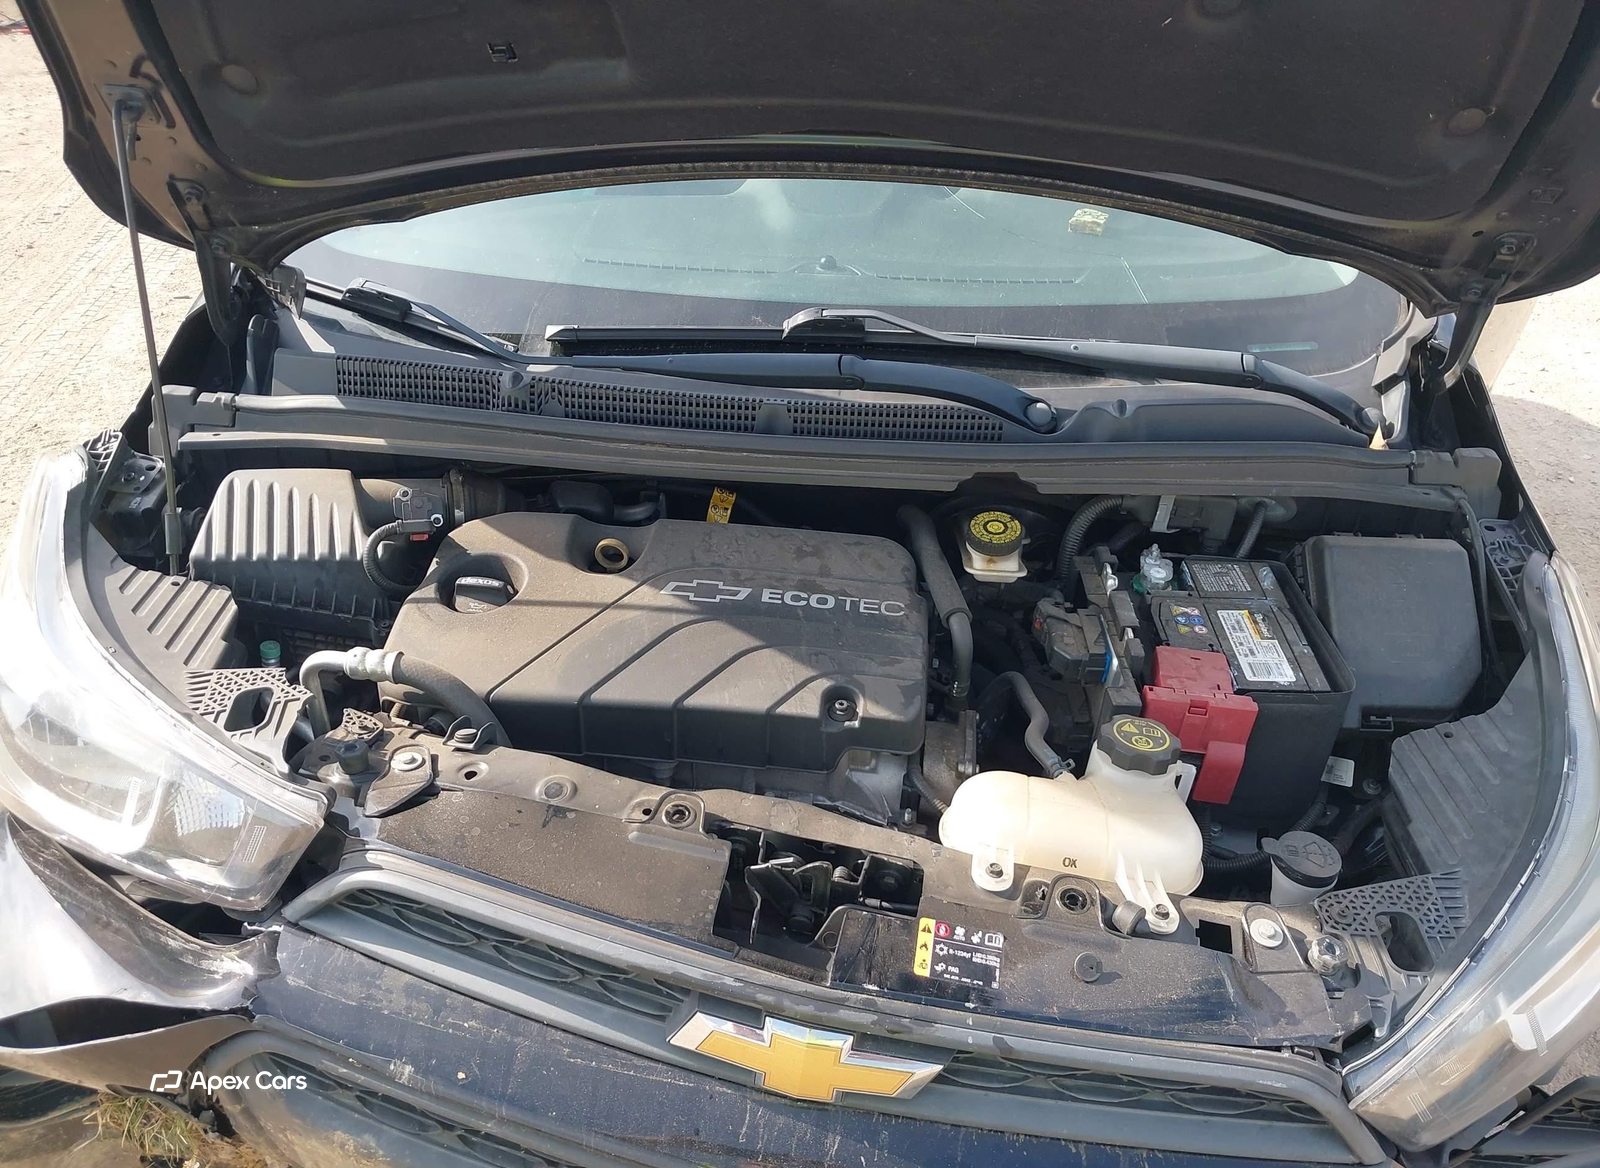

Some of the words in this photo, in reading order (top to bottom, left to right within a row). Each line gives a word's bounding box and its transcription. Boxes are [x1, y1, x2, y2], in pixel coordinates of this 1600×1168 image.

[462, 577, 499, 587] dexos
[761, 588, 906, 616] ECOTEC
[1062, 857, 1077, 868] OK
